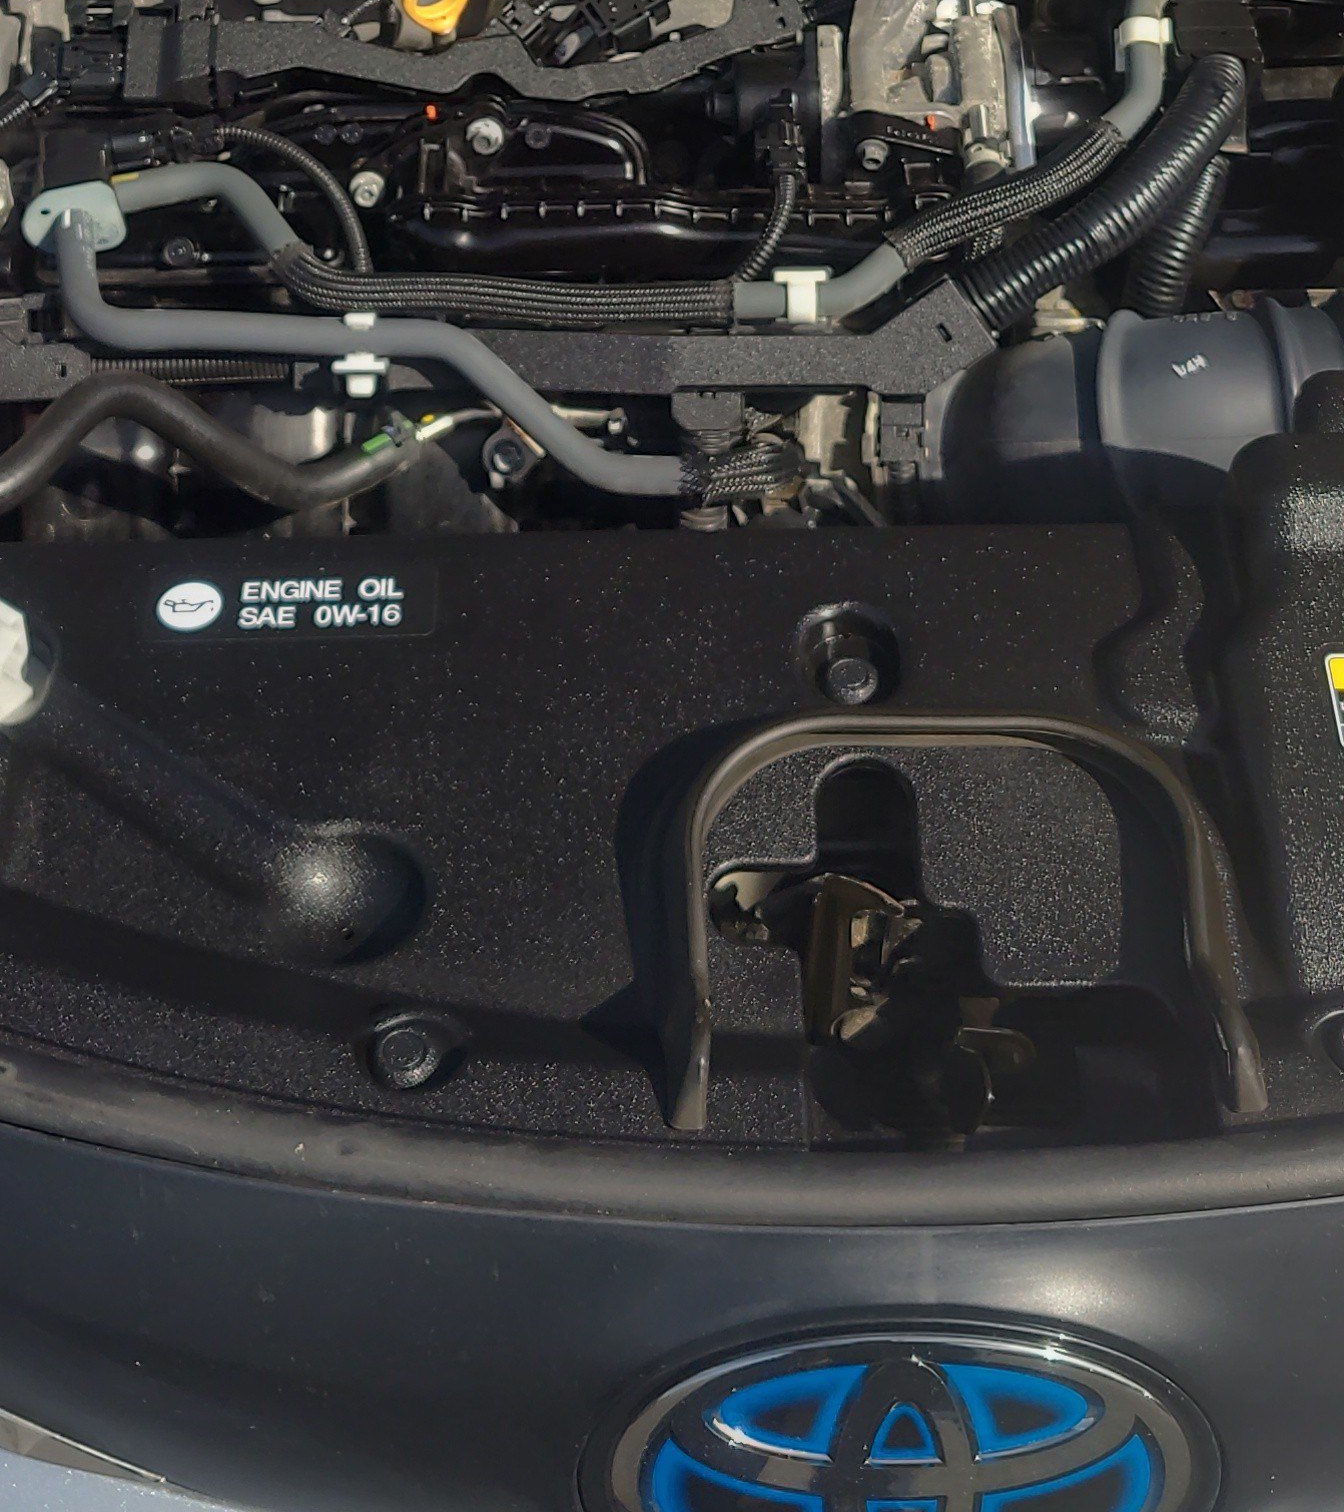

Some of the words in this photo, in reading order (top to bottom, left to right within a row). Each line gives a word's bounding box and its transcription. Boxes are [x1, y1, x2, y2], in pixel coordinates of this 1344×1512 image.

[241, 579, 344, 602] ENGINE
[358, 577, 405, 600] OIL
[238, 605, 297, 628] SAE
[314, 603, 403, 628] 0W-16
